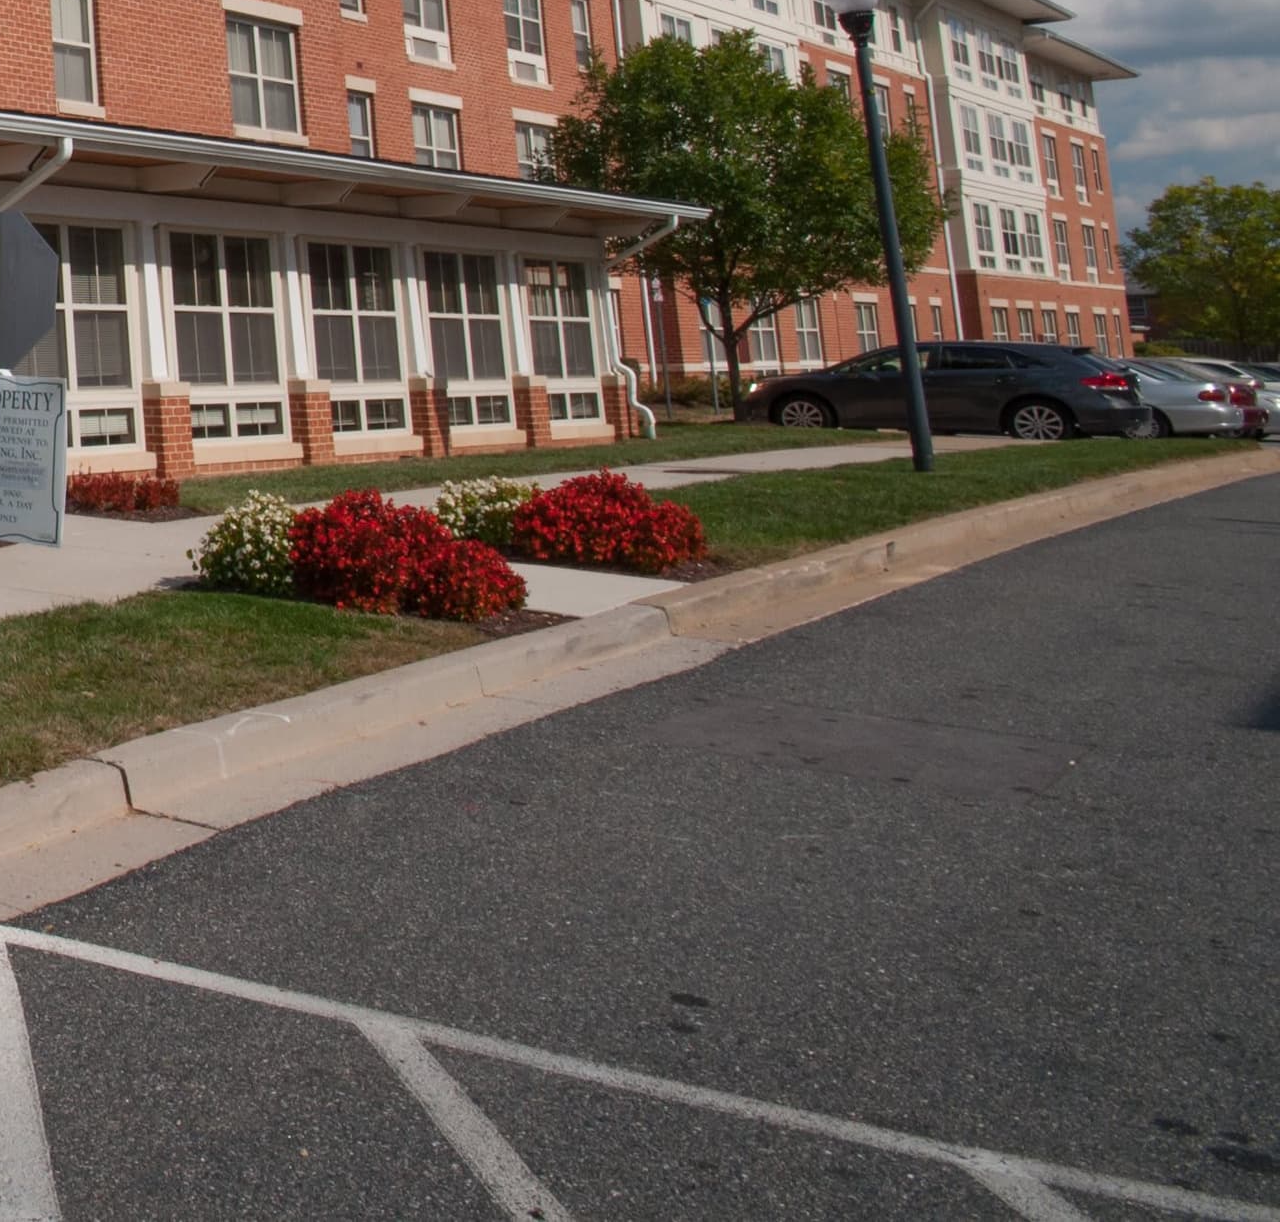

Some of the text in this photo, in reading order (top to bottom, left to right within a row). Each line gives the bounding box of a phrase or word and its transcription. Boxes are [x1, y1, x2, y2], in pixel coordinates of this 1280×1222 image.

[3, 415, 49, 428] PERMITTED
[25, 427, 36, 436] AT
[16, 500, 33, 511] DAY
